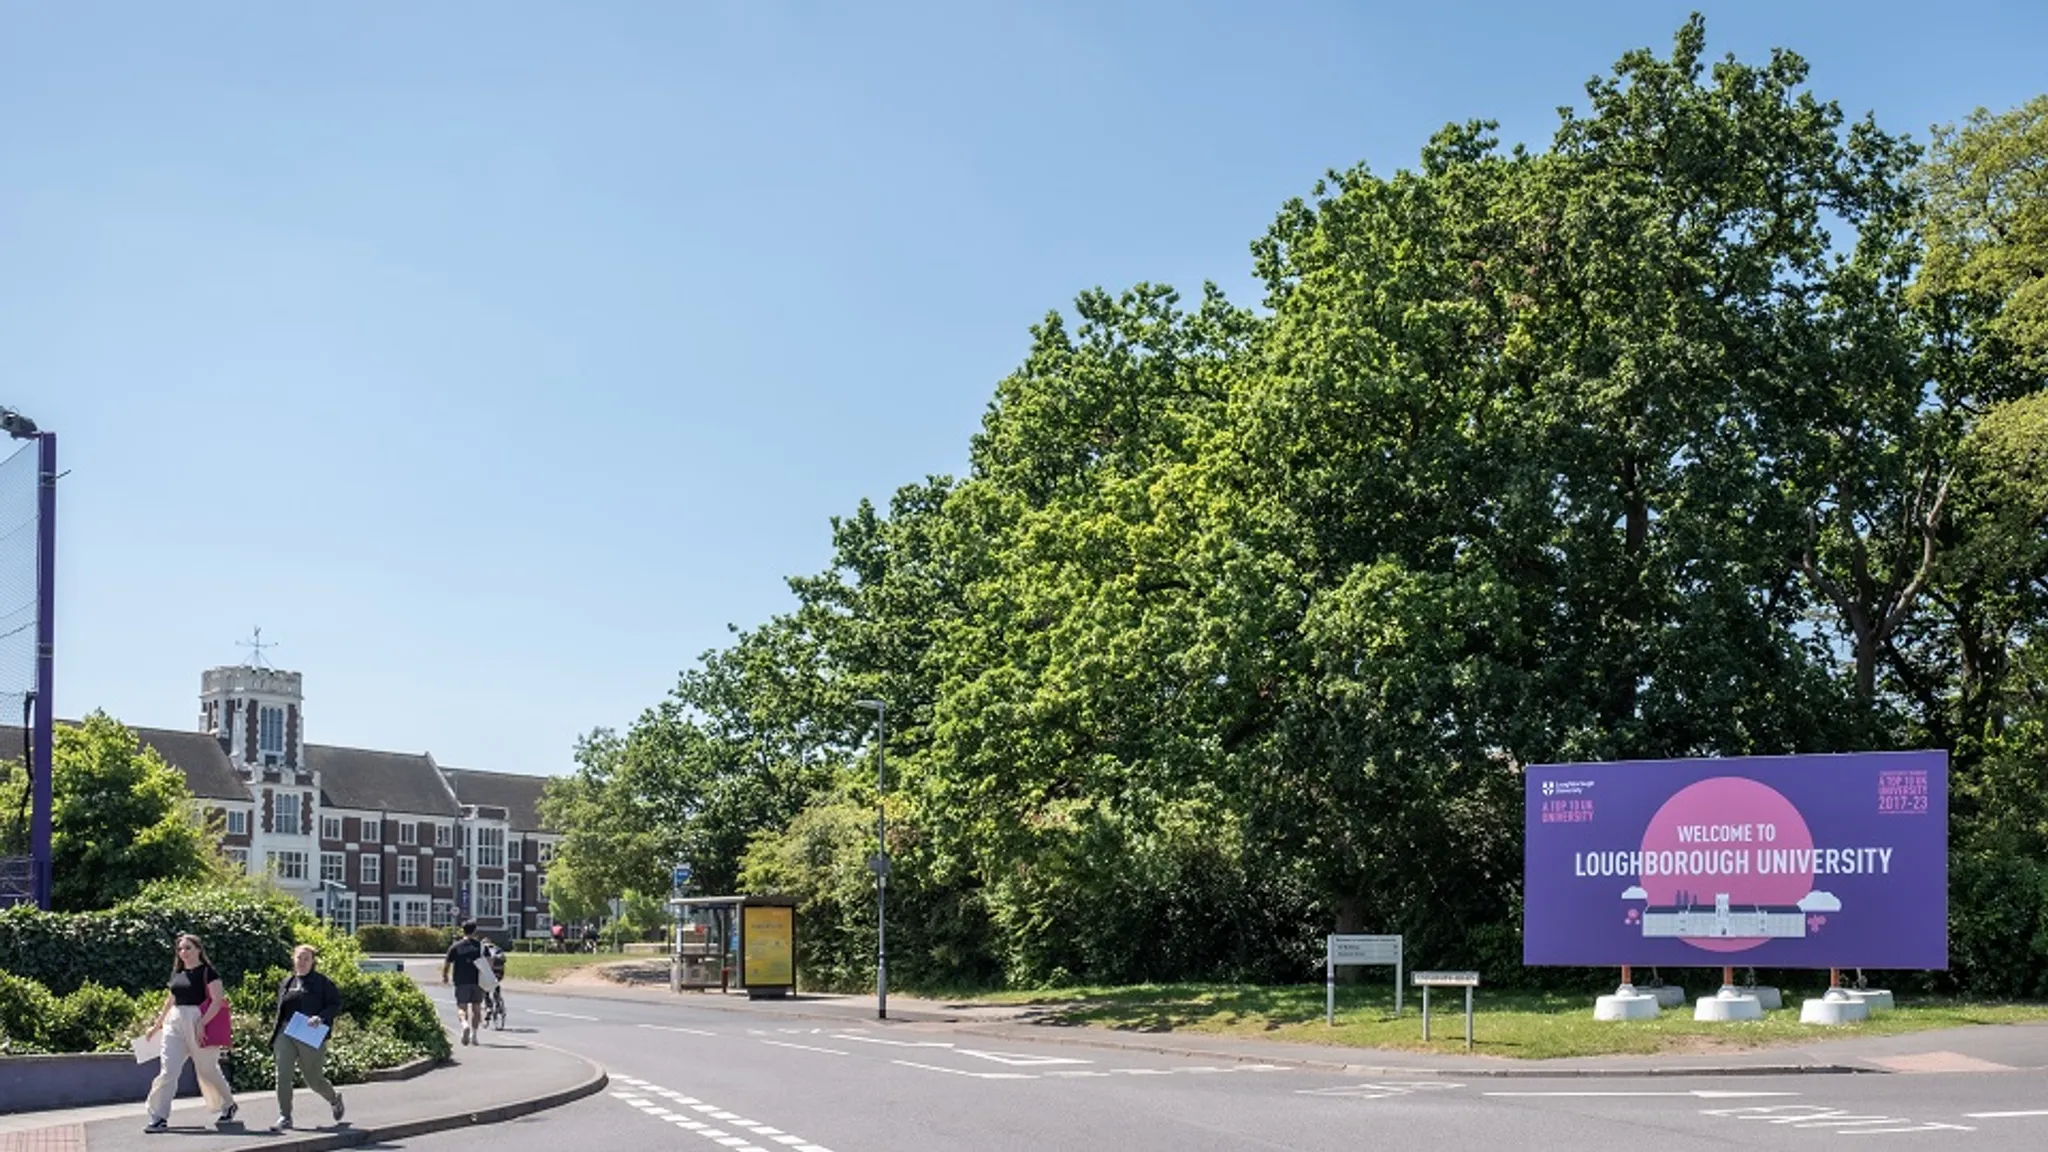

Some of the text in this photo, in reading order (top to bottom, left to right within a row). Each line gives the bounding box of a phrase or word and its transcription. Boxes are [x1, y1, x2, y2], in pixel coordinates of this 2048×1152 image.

[1879, 795, 1928, 810] 2017-23
[1676, 823, 1776, 843] WELCOME TO
[1575, 847, 1894, 877] LOUGHBOROUGH UNIVERSITY
